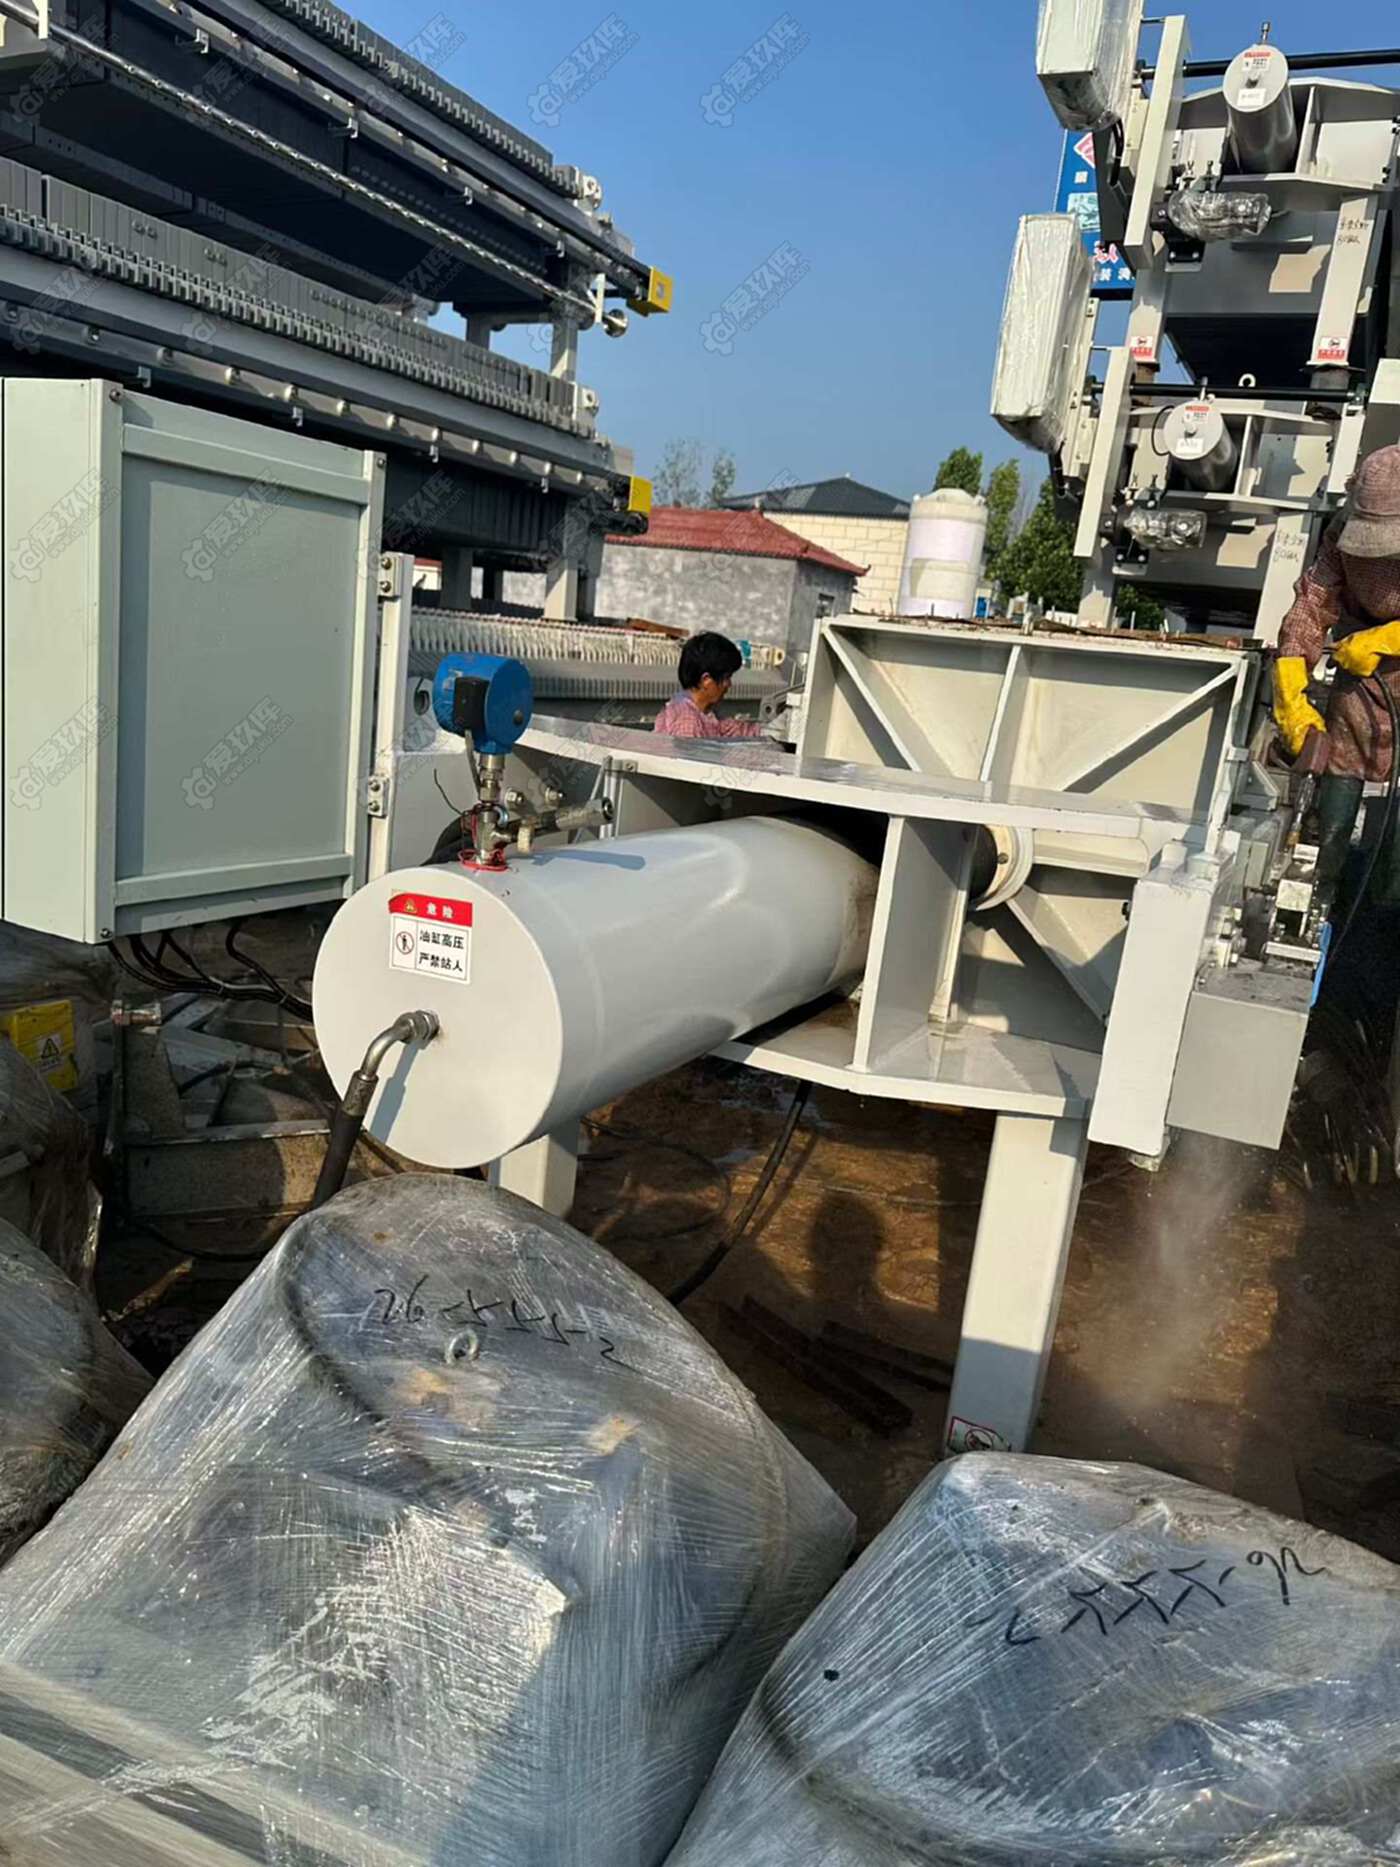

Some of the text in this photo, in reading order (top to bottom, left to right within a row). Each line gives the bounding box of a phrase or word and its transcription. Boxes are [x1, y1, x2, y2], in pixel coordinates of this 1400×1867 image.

[419, 929, 464, 950] 油缸高压
[418, 951, 463, 972] 严禁站人
